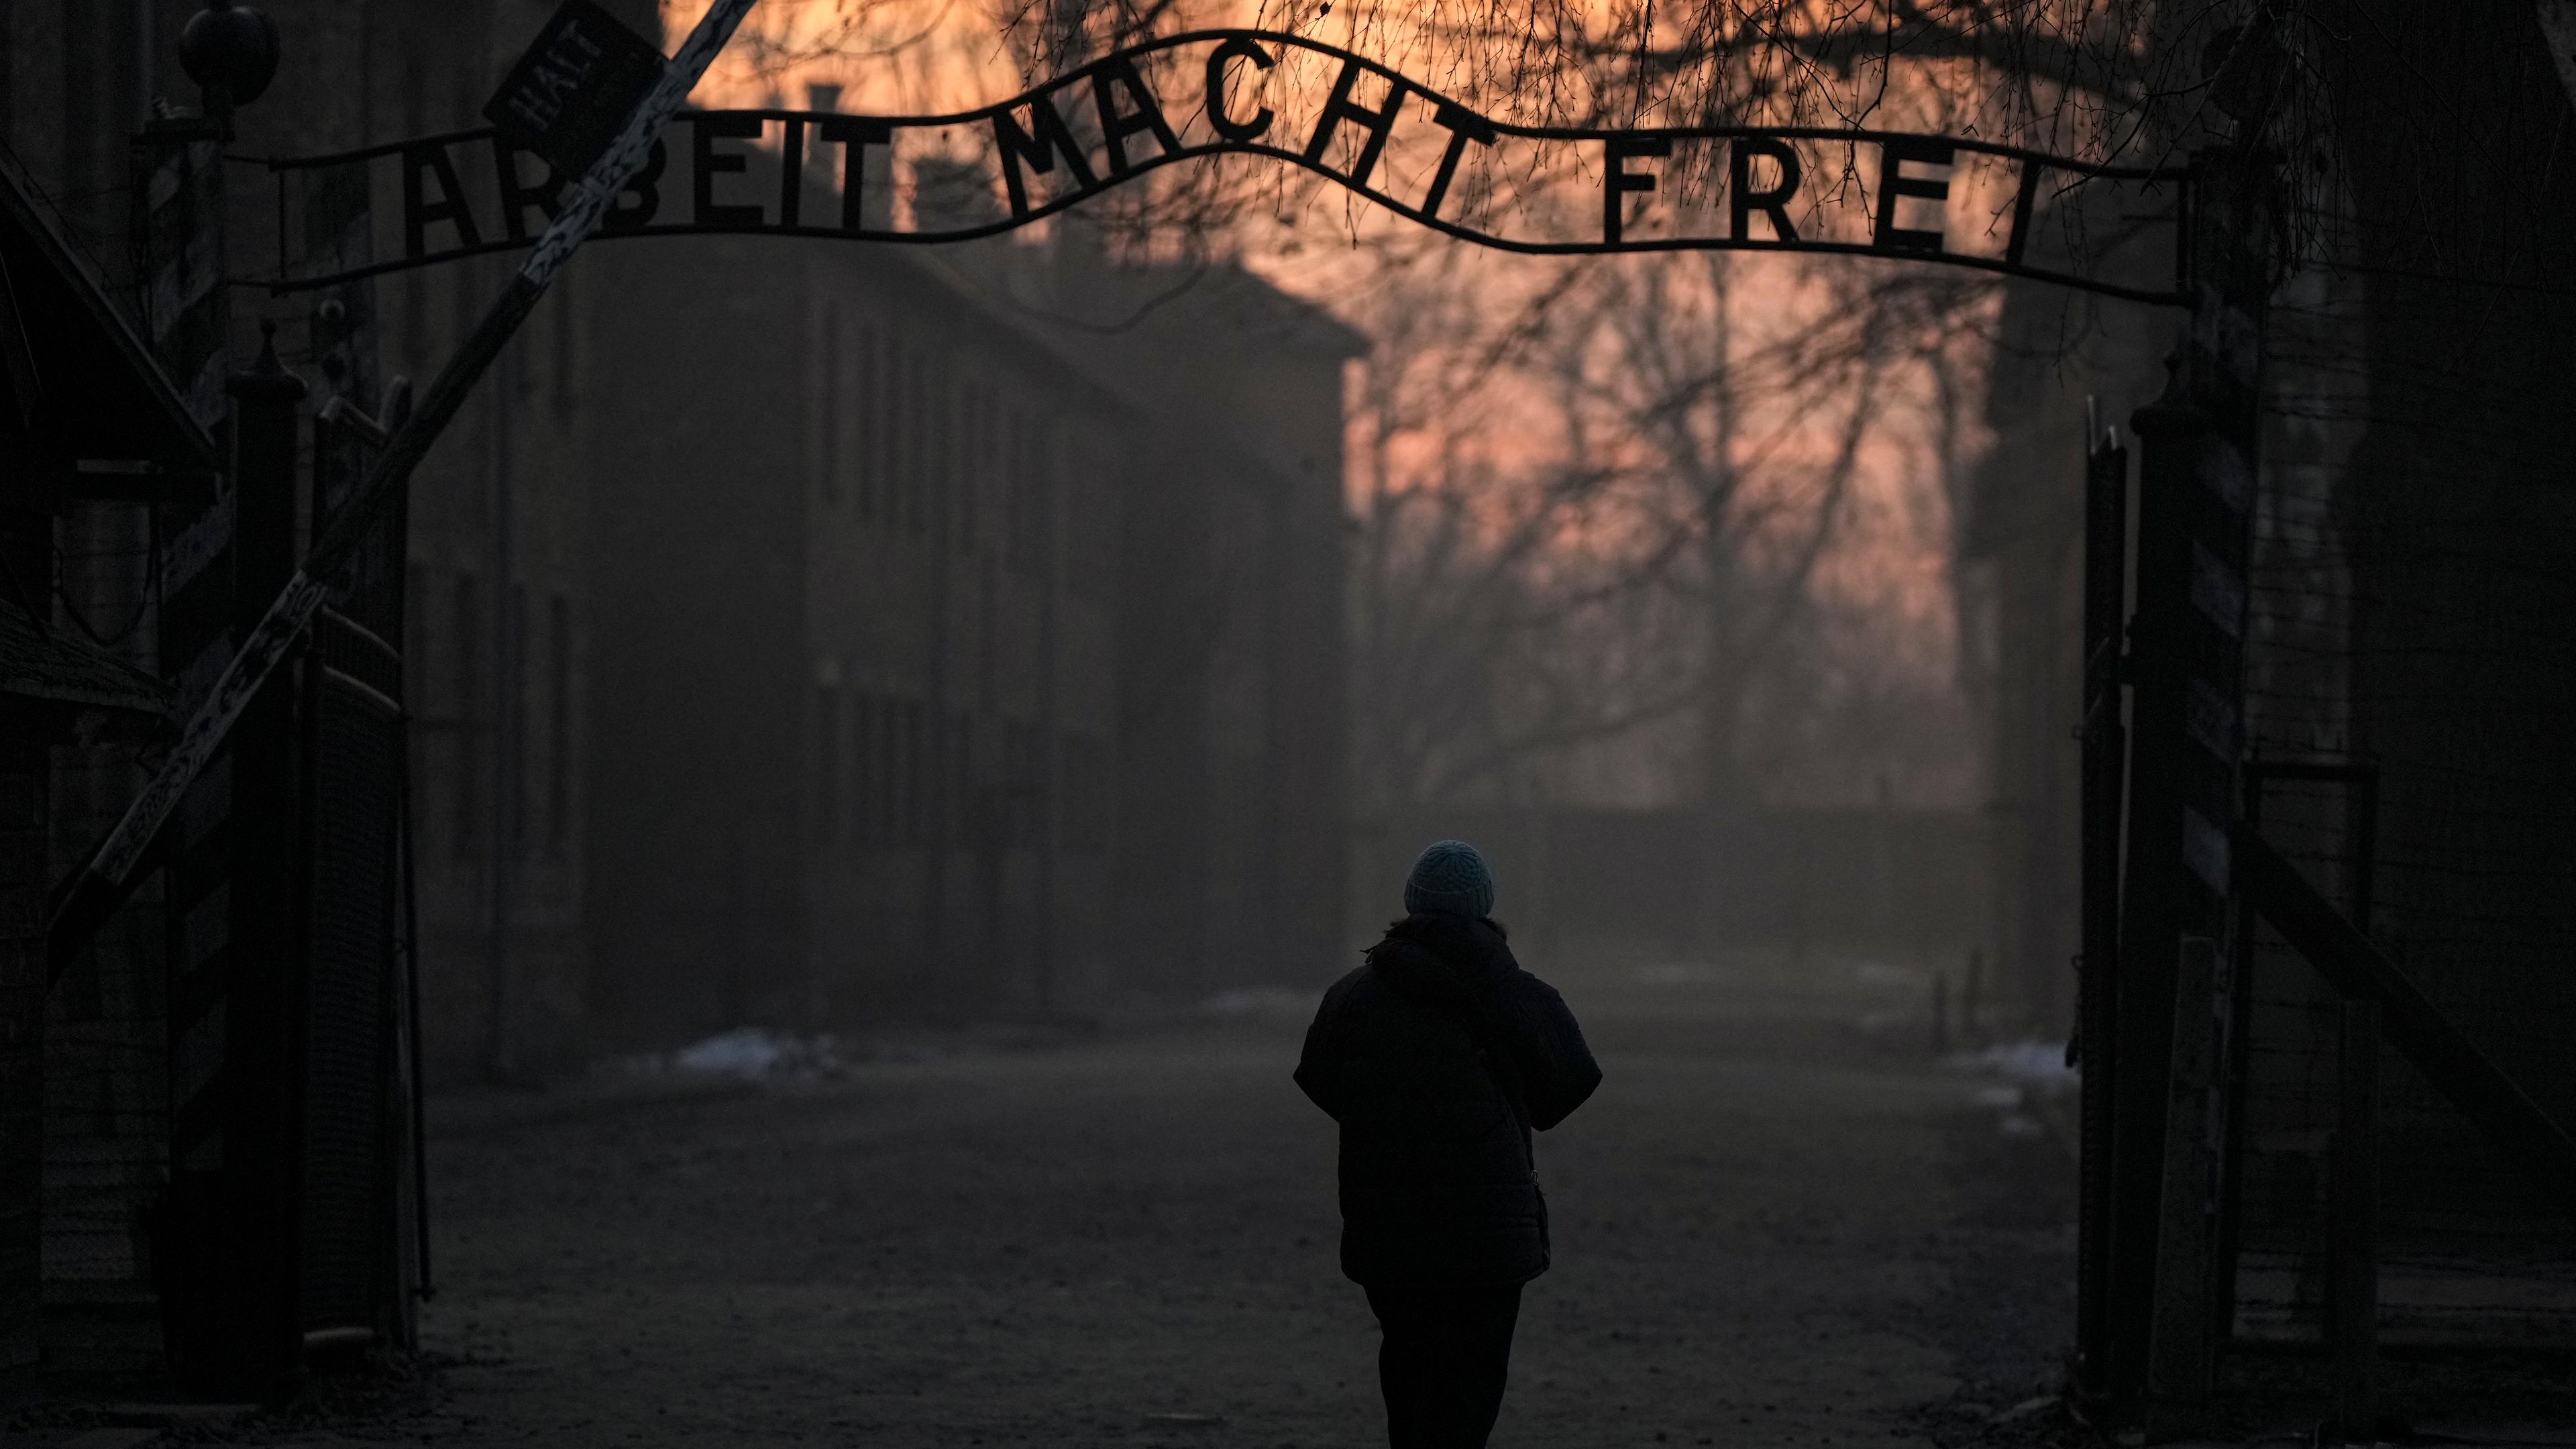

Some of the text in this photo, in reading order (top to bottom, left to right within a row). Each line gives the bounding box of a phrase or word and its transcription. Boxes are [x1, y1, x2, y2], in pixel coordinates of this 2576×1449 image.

[506, 18, 602, 130] HALT
[990, 35, 1495, 221] MACHT
[1605, 132, 2041, 268] FREI
